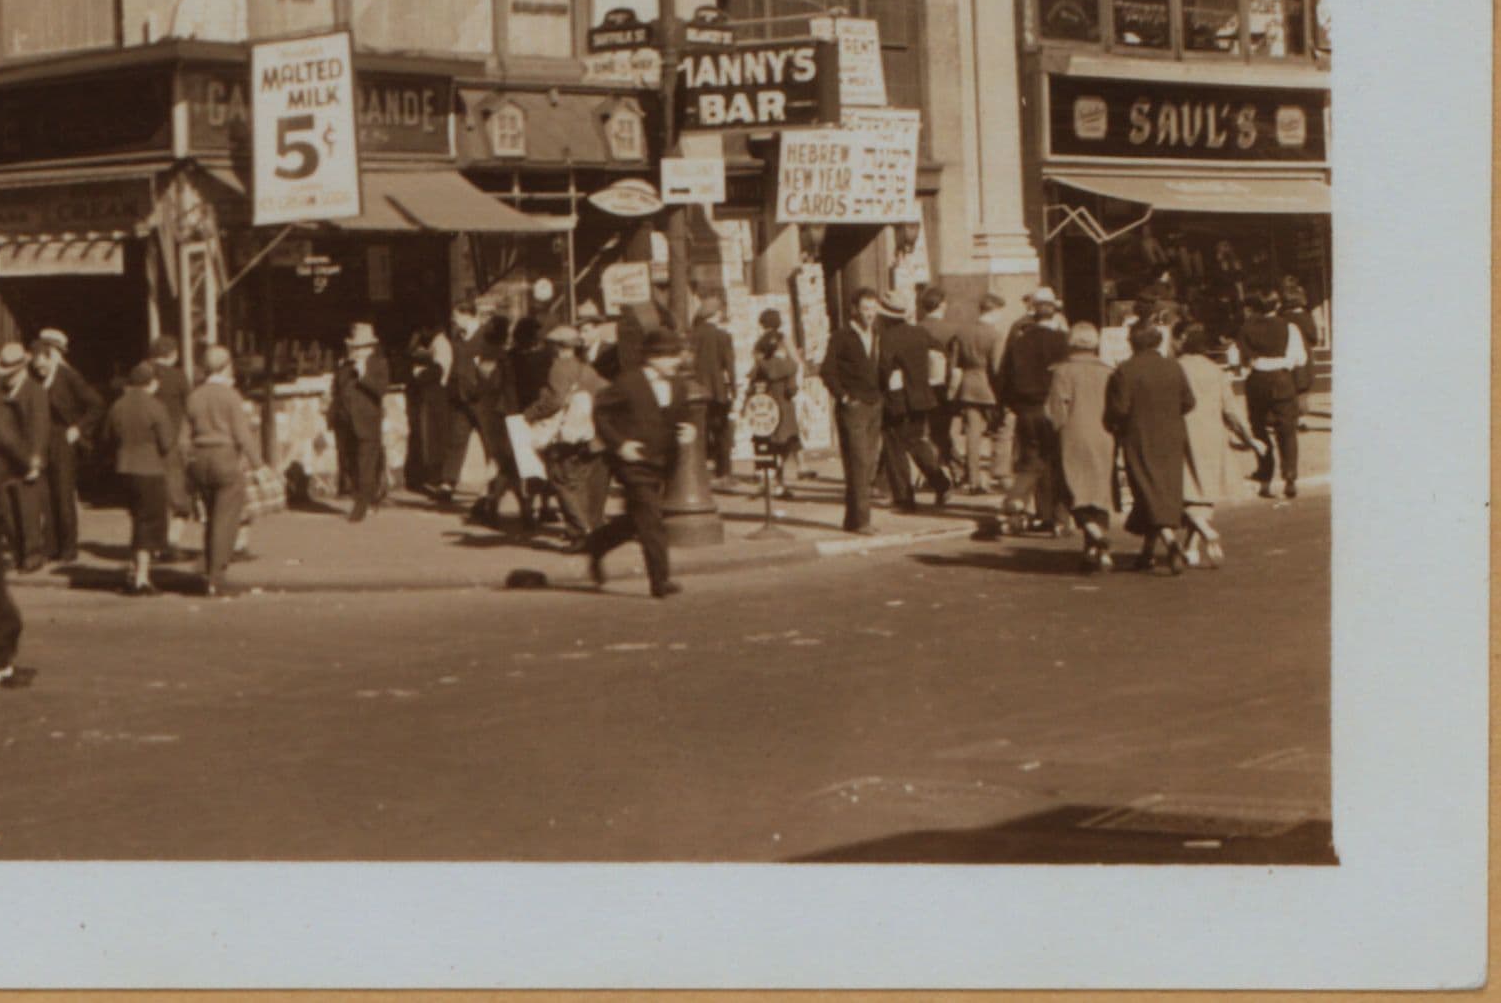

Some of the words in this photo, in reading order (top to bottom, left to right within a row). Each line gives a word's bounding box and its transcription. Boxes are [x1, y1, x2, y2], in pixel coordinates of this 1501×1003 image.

[262, 58, 344, 92] MALTED
[287, 85, 340, 110] MILK
[357, 89, 436, 132] ANDE
[699, 90, 787, 126] BAR
[1128, 100, 1257, 149] SAUL'S
[785, 143, 849, 164] HEBREW
[784, 167, 813, 192] NEW
[819, 166, 852, 193] YEAR
[785, 193, 849, 217] CARDS
